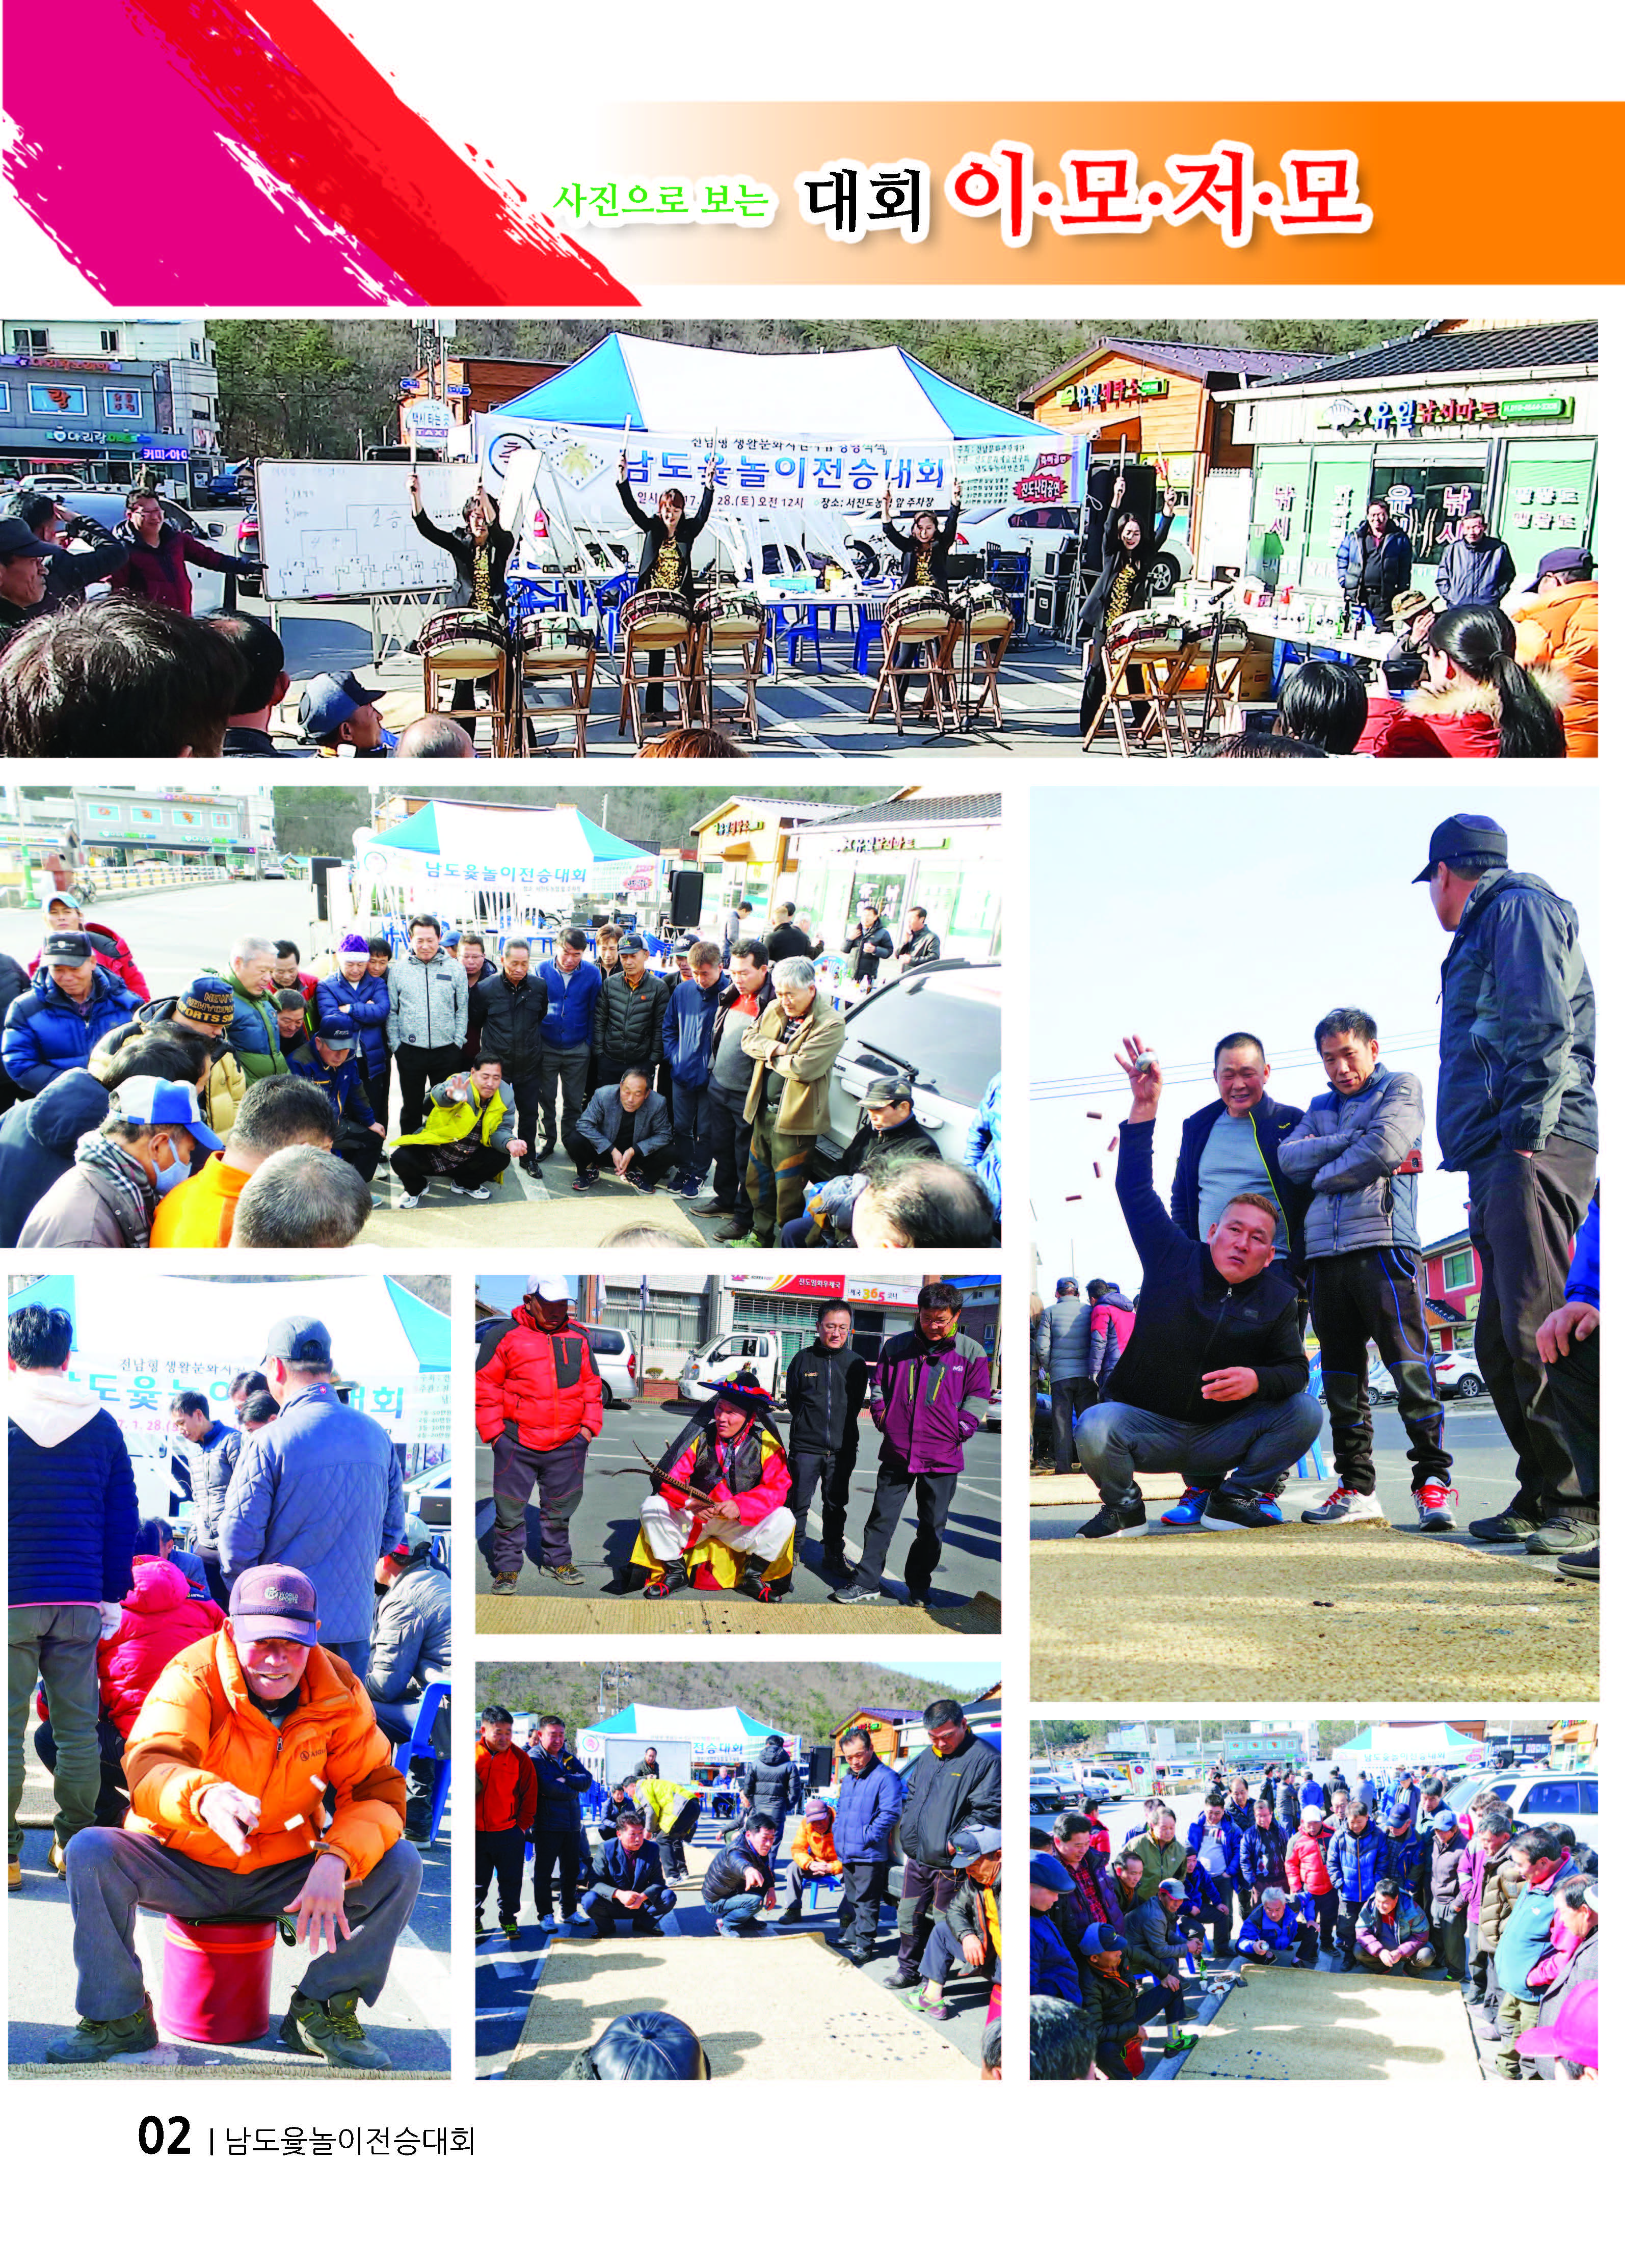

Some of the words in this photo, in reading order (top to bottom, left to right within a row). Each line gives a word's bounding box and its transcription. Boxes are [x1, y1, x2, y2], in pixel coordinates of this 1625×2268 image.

[1020, 478, 1061, 499] 진도난타공연
[758, 497, 779, 507] 오전
[781, 498, 804, 509] 12시
[907, 497, 935, 508] 주차장
[425, 861, 587, 884] 남도윷놀이전승대회
[798, 1277, 841, 1289] 진도임회우체국
[862, 1288, 886, 1302] 365
[888, 1292, 897, 1300] 코너
[279, 1596, 298, 1604] SPORTS
[692, 1742, 743, 1755] 전승대회
